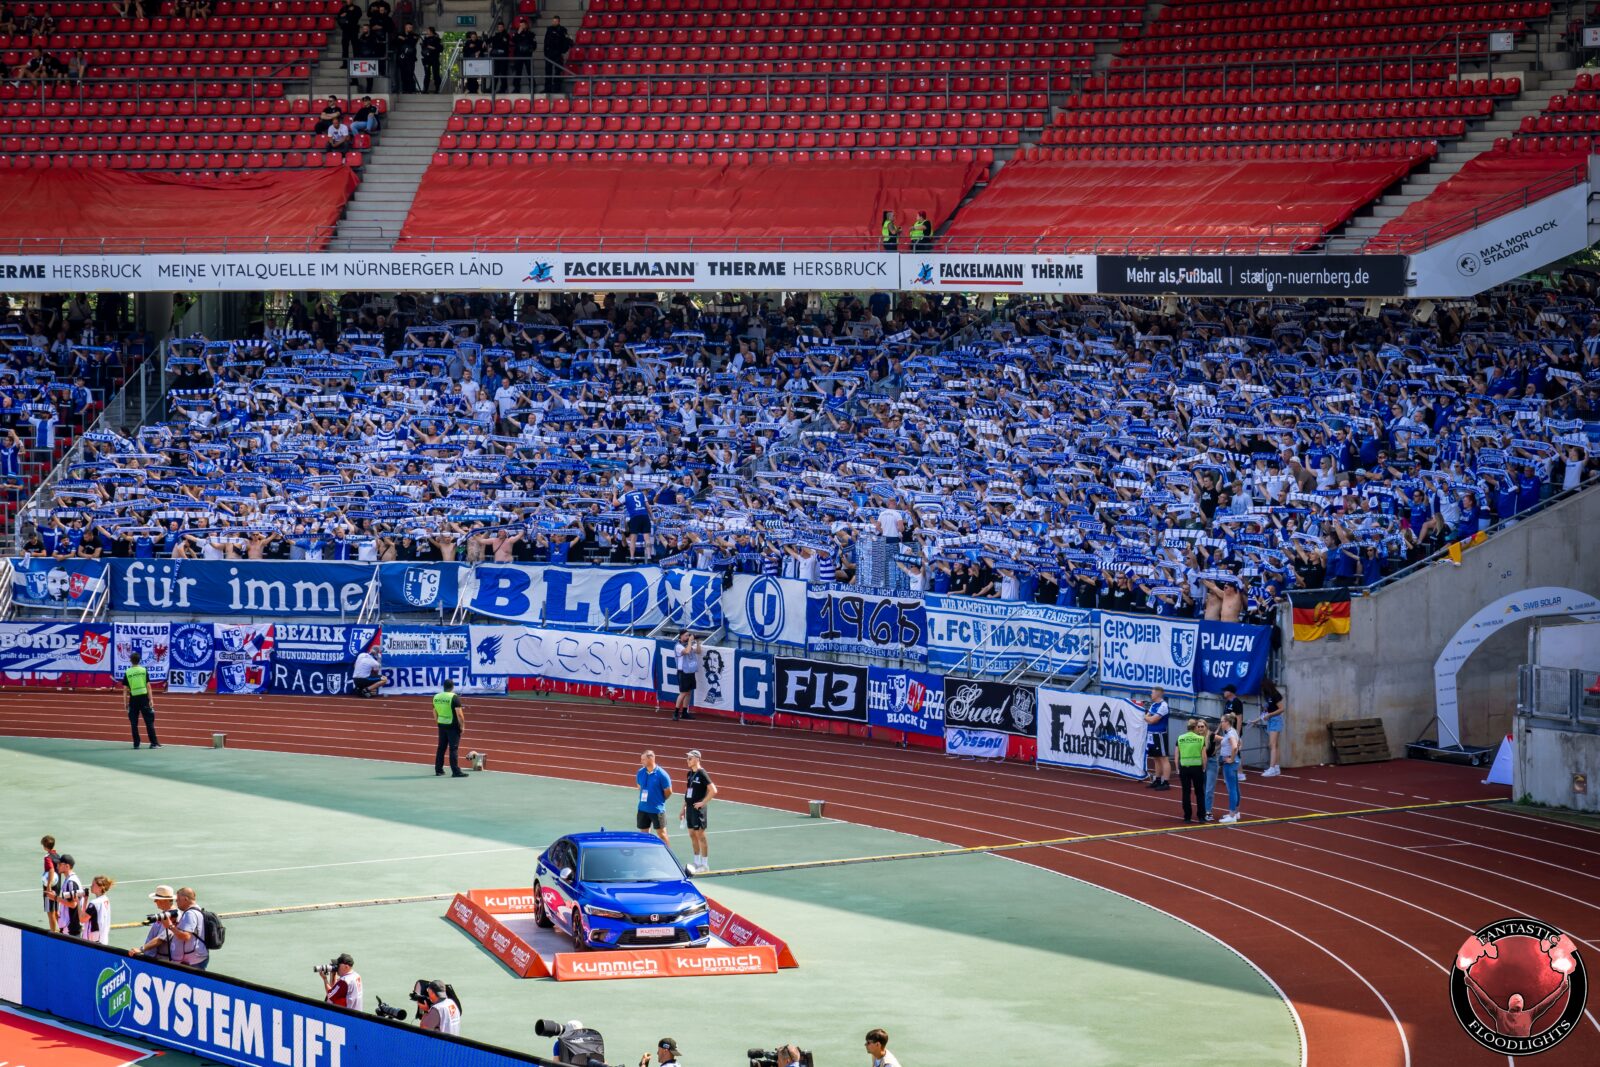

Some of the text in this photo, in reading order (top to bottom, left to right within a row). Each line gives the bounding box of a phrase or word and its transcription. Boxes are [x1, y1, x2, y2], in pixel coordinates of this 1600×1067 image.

[1479, 219, 1559, 258] MAX MORLOCK
[1483, 241, 1529, 266] STADION
[53, 263, 142, 279] HERSBRUCK
[158, 264, 206, 278] MEINE
[210, 263, 316, 280] VITALQUELLE
[321, 262, 338, 277] IM
[344, 258, 454, 277] NÜRNBERGER
[564, 260, 887, 276] FACKELMANN THERME HERSBRUCK
[939, 263, 1084, 280] FACKELMANN THERME
[1126, 266, 1223, 285] Mehr als Fußball
[1239, 267, 1370, 289] stadion-nuernberg.de
[633, 495, 642, 508] 5
[122, 561, 195, 607] für
[829, 583, 838, 591] IST
[877, 587, 895, 597] NICHT
[468, 566, 723, 628] BLOCK
[940, 597, 956, 609] WIR
[992, 605, 1006, 616] MIT
[1523, 596, 1562, 611] SWB SOLAR
[115, 624, 169, 636] FANCLUB
[819, 593, 921, 648] 1965
[928, 617, 971, 643] 1.FC
[0, 628, 80, 649] BÖRDE
[274, 624, 347, 643] BEZIRK
[1201, 632, 1255, 653] PLAUEN
[276, 650, 345, 662] NEUNUNDDREISSIG
[1103, 640, 1129, 661] 1.FC
[170, 670, 185, 685] ES
[381, 667, 478, 688] BREMEN
[1103, 660, 1192, 688] MAGDEBURG
[1212, 660, 1234, 679] OST
[887, 712, 928, 730] BLOCK U
[484, 895, 534, 907] kumm
[572, 957, 658, 973] kummich
[677, 954, 762, 968] kummich
[101, 970, 126, 999] SYSTEM
[112, 990, 127, 1010] LIFT
[132, 971, 346, 1067] SYSTEM LIFT
